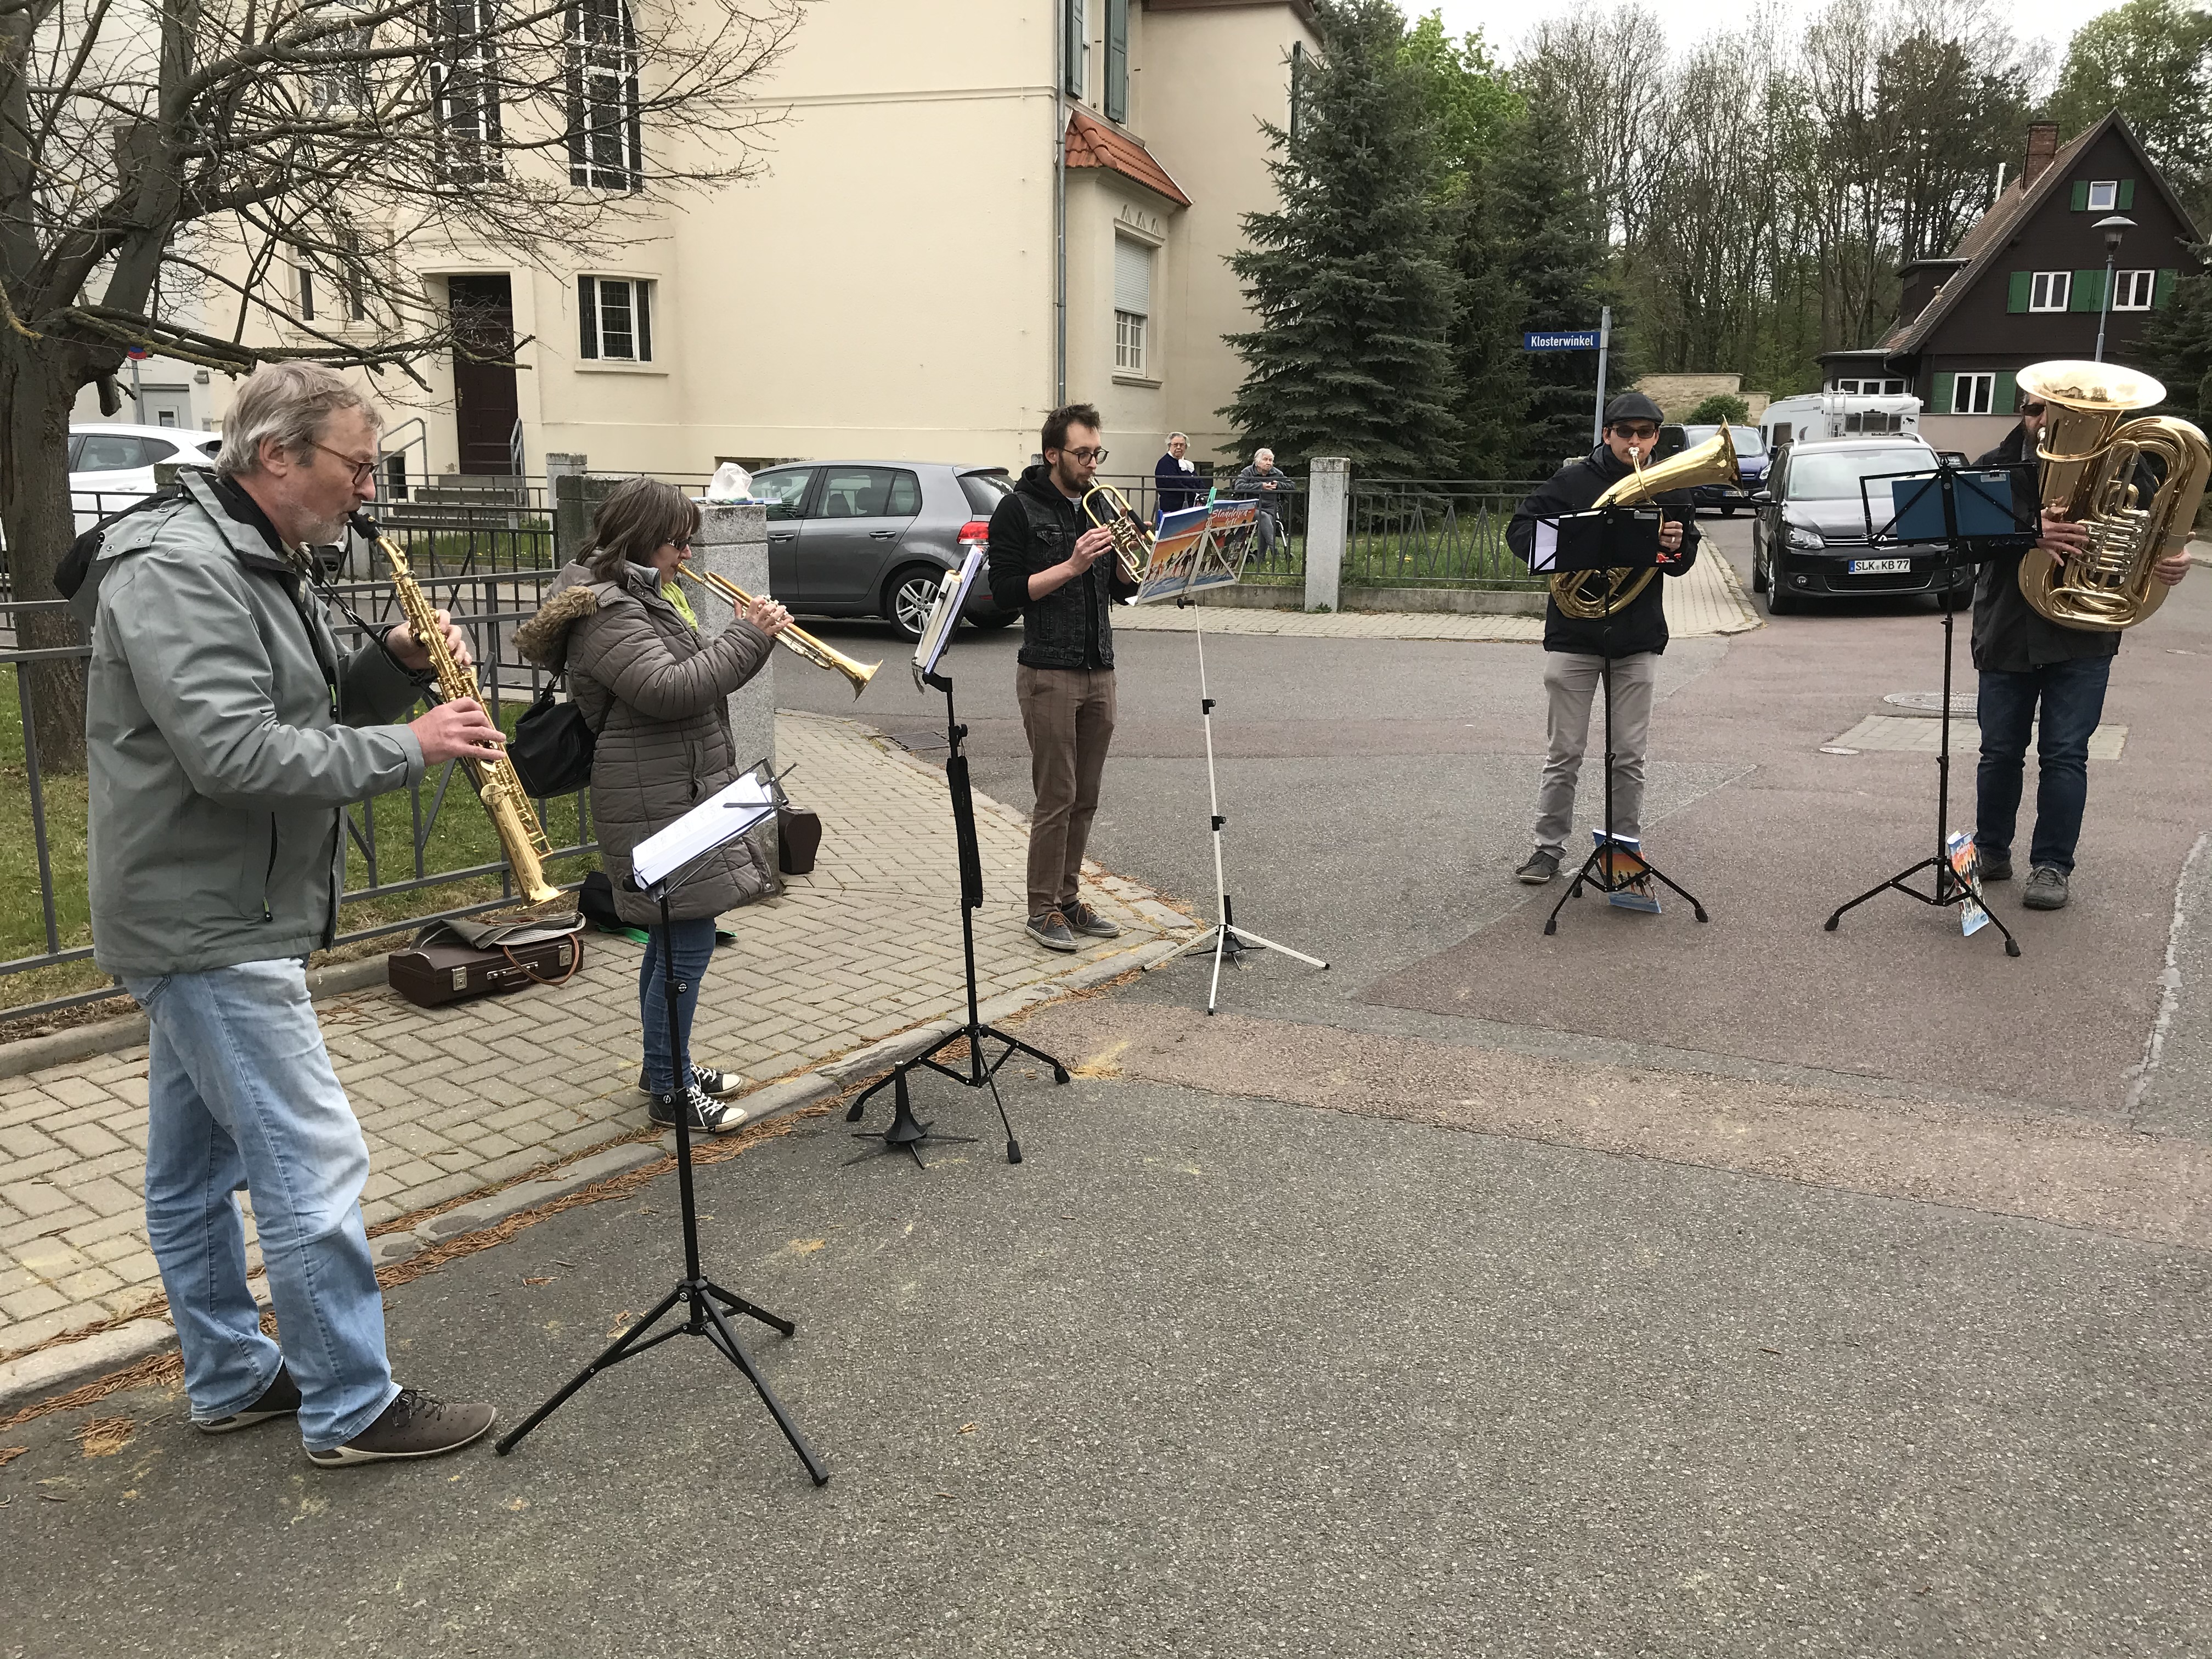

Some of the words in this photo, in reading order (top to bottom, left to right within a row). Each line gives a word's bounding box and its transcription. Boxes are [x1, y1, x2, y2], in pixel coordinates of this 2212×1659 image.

[1531, 335, 1593, 347] Klosterwinkel
[1855, 561, 1875, 571] SLK
[1881, 560, 1895, 570] KB
[1897, 560, 1909, 569] 77
